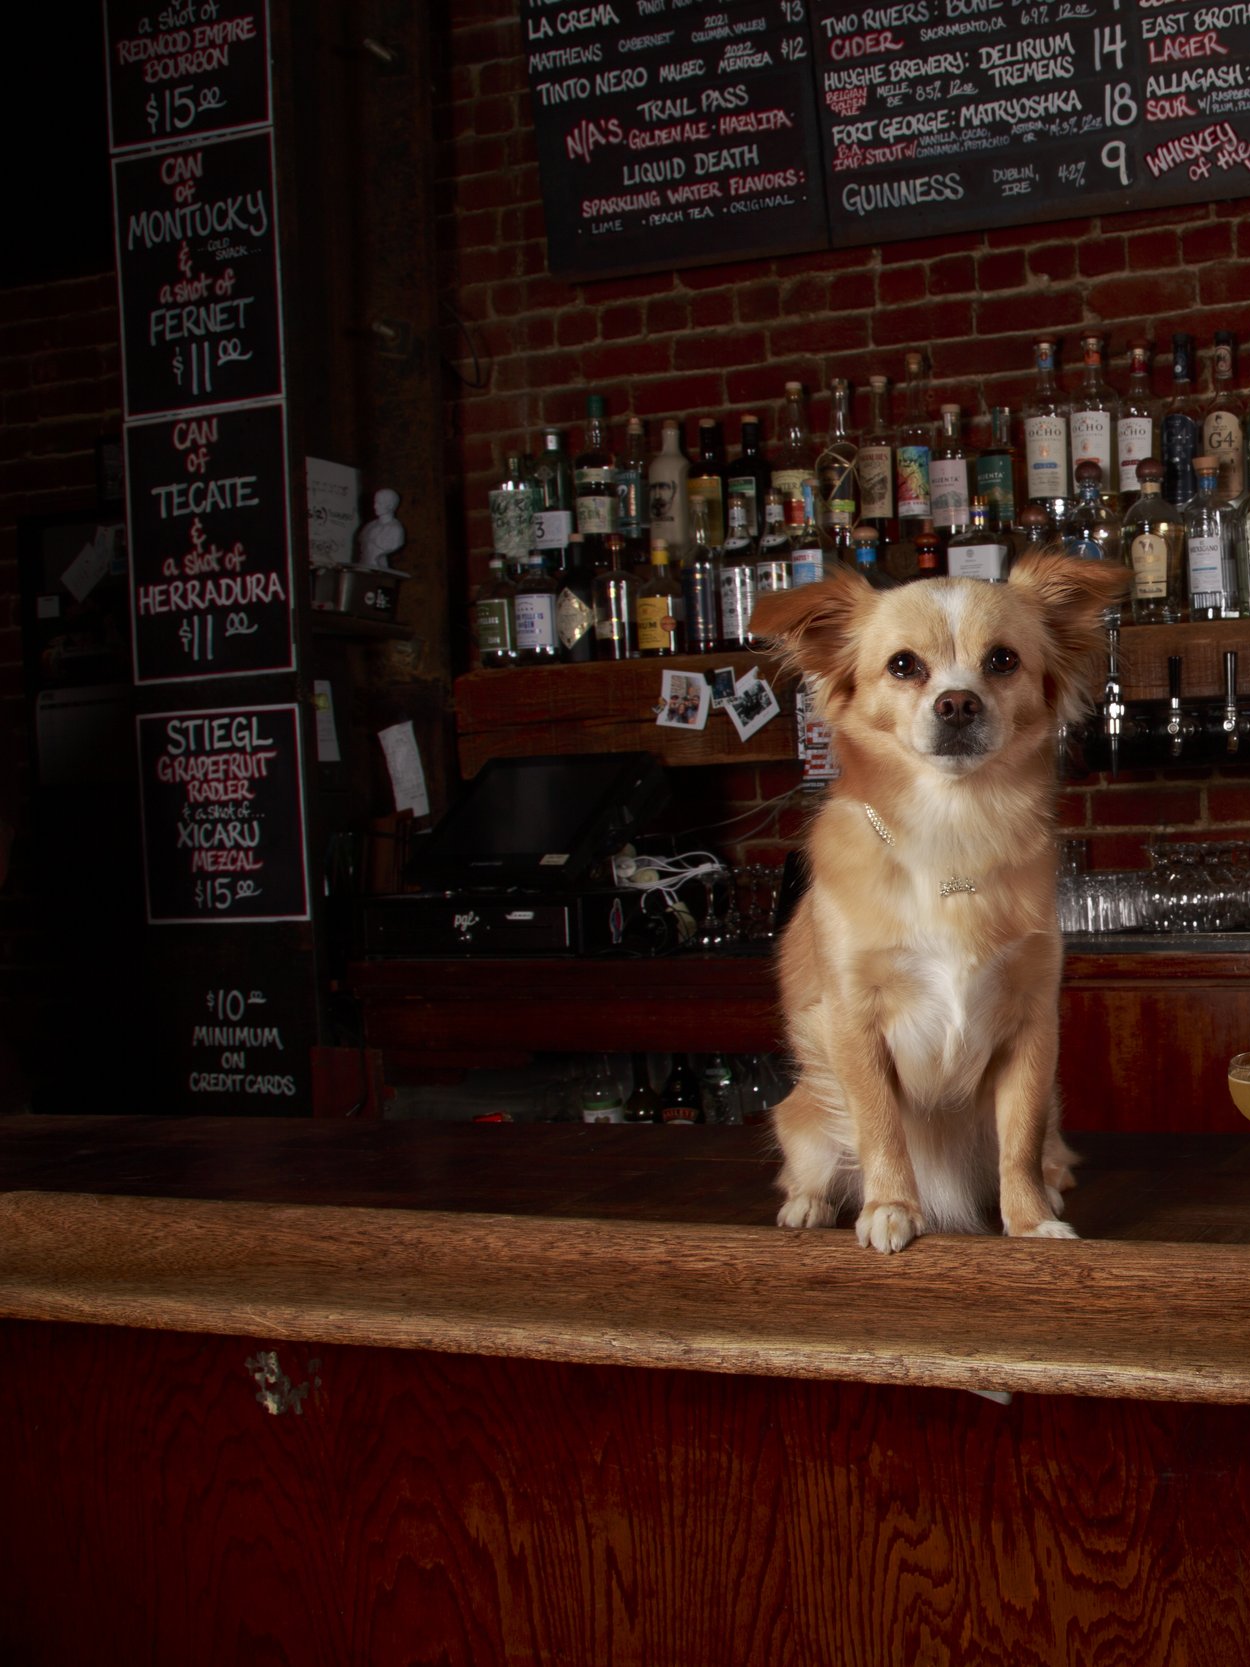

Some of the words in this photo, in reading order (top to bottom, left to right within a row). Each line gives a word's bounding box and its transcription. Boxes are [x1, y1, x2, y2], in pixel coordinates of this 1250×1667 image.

[528, 16, 554, 41] LA
[557, 3, 621, 34] CREMA
[820, 14, 859, 38] TWO
[1141, 12, 1190, 39] EAST
[117, 31, 191, 65] REDWOOD
[193, 16, 257, 48] EMPIRE
[528, 43, 603, 75] MATTHEWS
[618, 29, 676, 53] CABERNET
[733, 17, 767, 34] VALLEY
[830, 30, 904, 60] CIDER
[978, 32, 1076, 70] DELIRIUM
[1093, 24, 1127, 71] 14
[1150, 31, 1229, 63] LAGER
[143, 45, 229, 83] BOURBON
[536, 77, 591, 107] TINTO
[595, 66, 648, 96] NERO
[658, 59, 706, 84] MALBEC
[717, 51, 773, 75] MENDOZA
[780, 36, 808, 61] $12
[824, 64, 887, 91] HUYGHE
[988, 56, 1075, 88] TREMENS
[637, 97, 697, 123] TRAIL
[700, 84, 750, 112] PASS
[832, 120, 878, 146] FORT
[959, 89, 1082, 128] MATRYOSHKA
[1104, 82, 1138, 127] 18
[1146, 95, 1197, 121] SOUR
[628, 125, 682, 150] GOLDEN
[683, 120, 712, 141] ALE
[1145, 121, 1238, 179] WHISKEY
[160, 152, 204, 185] CAN
[623, 156, 686, 186] LIQUID
[694, 144, 760, 176] DEATH
[865, 141, 907, 166] STOUT
[1101, 140, 1130, 186] 9
[1189, 156, 1212, 181] of
[1217, 141, 1250, 170] the
[174, 181, 196, 203] of
[581, 190, 661, 218] SPARKLING
[666, 181, 723, 205] WATER
[842, 172, 965, 216] GUINNESS
[127, 190, 268, 251] MONTUCKY
[591, 219, 624, 235] LIME
[649, 209, 684, 227] PEACH
[687, 206, 715, 221] TEA
[729, 194, 795, 215] ORIGINAL
[174, 273, 212, 303] shot
[215, 267, 237, 296] of
[149, 295, 255, 347] FERNET
[172, 417, 219, 450] CAN
[1029, 429, 1062, 437] OCHO
[1209, 432, 1234, 449] G4
[186, 447, 211, 475] of
[150, 475, 260, 519] TECATE
[536, 522, 545, 539] 3
[184, 544, 224, 577] shot
[225, 541, 247, 573] of
[138, 571, 286, 617] HERRADURA
[166, 715, 274, 755] STIEGL
[156, 750, 278, 784] GRAPEFRUIT
[186, 780, 256, 804] RADLER
[176, 820, 261, 849] XICARU
[192, 850, 264, 874] MEZCAL
[192, 1025, 285, 1051] MINIMUM
[221, 1050, 246, 1070] ON
[189, 1071, 246, 1093] CREDIT
[245, 1074, 296, 1097] CARDS
